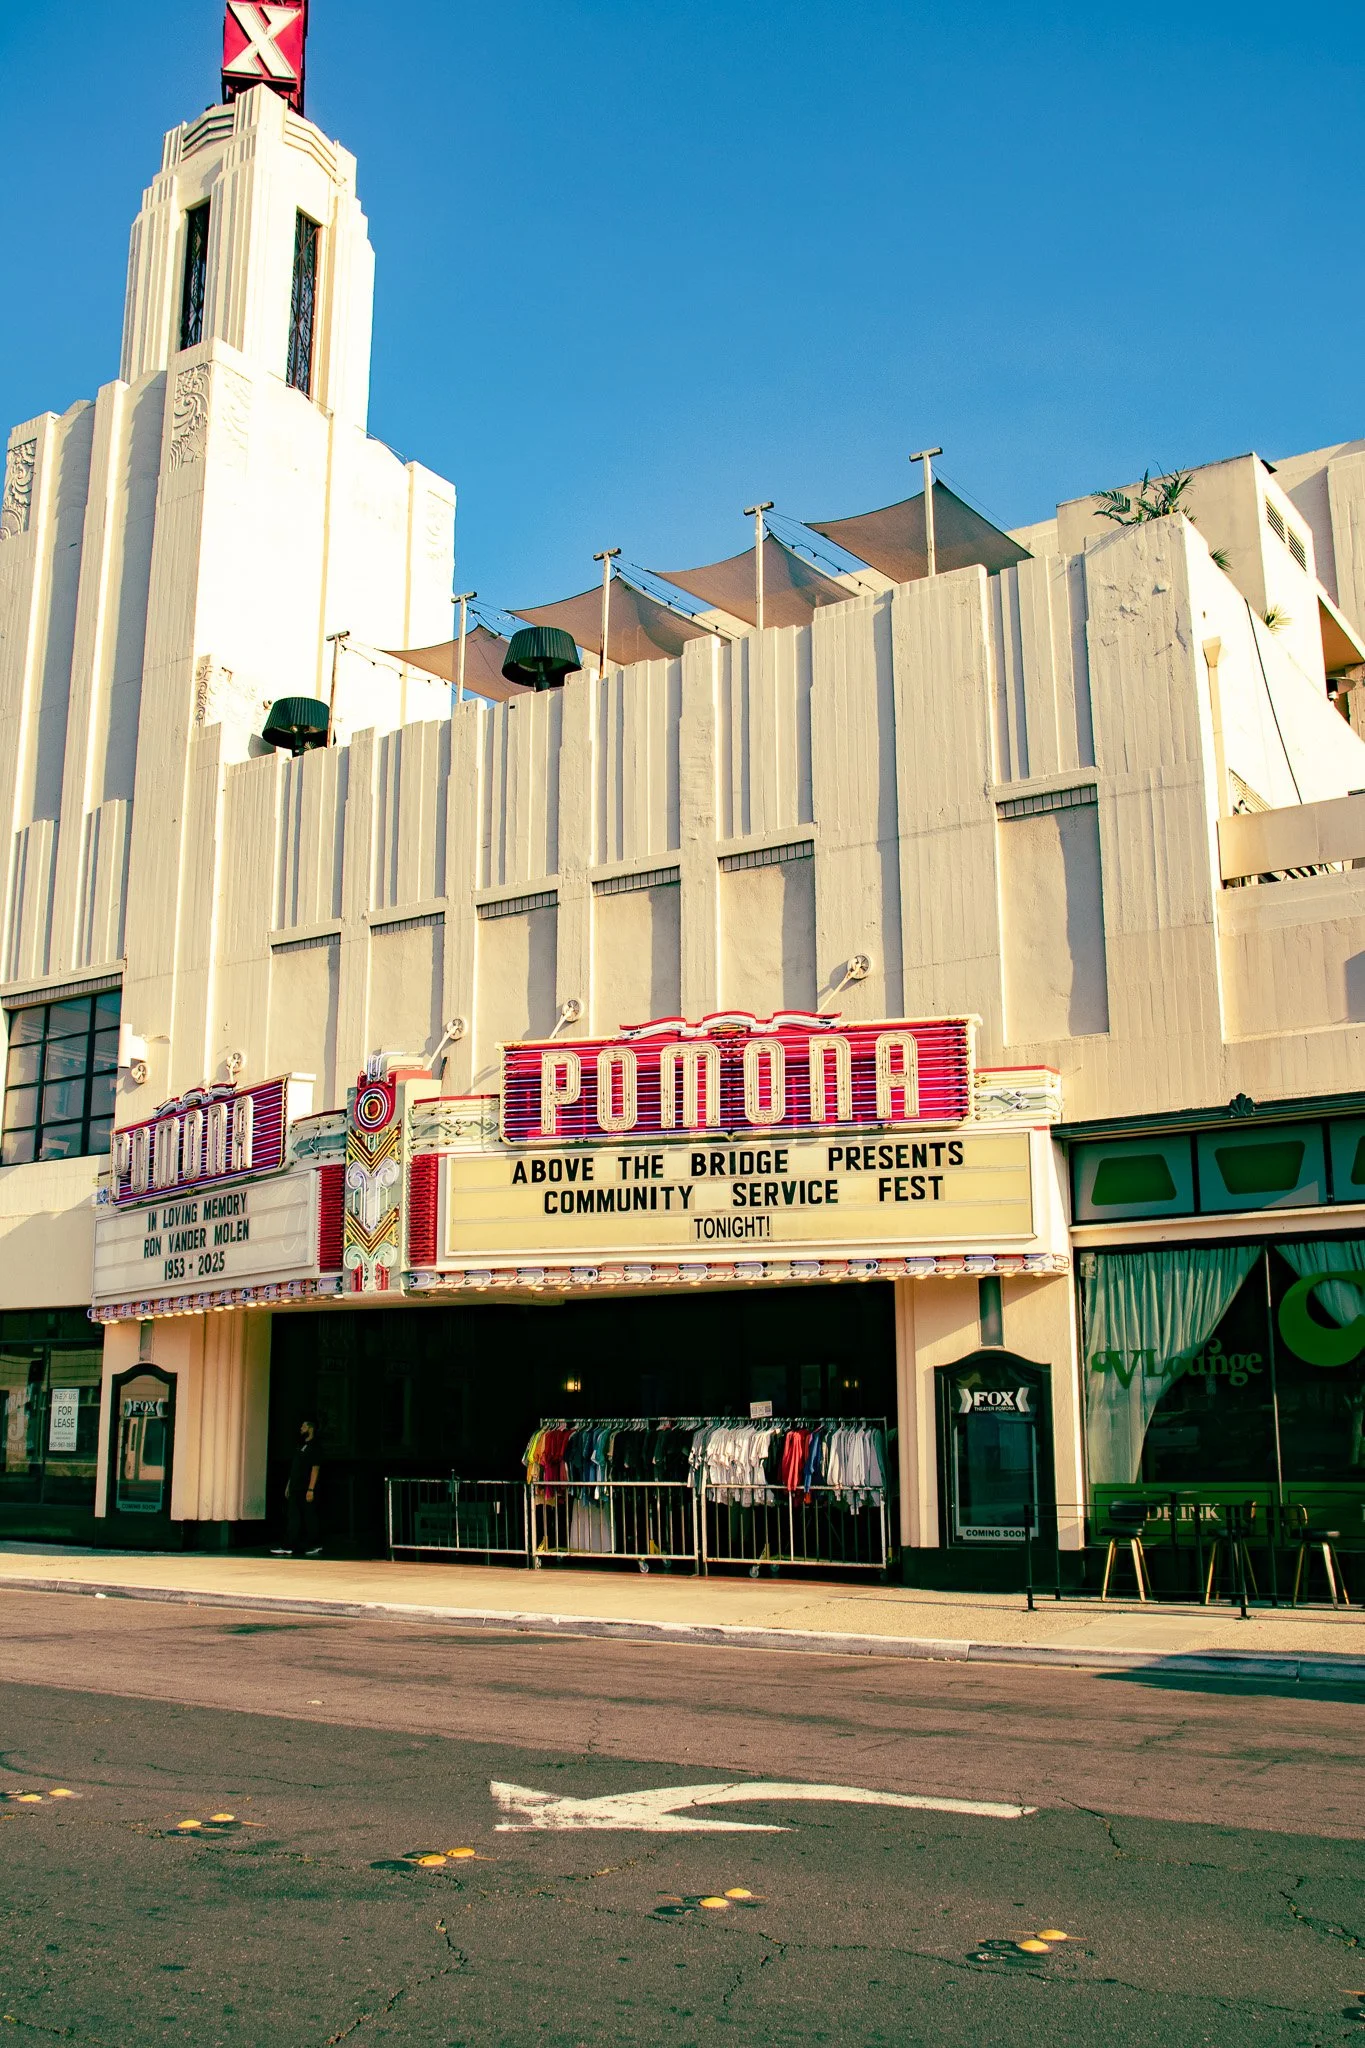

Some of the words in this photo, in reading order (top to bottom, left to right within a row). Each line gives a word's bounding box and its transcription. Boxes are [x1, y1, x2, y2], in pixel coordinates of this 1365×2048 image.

[223, 2, 301, 79] X
[541, 1032, 920, 1135] POMONA
[112, 1095, 254, 1200] POMONA
[512, 1158, 594, 1184] ABOVE
[617, 1154, 664, 1180] THE
[691, 1150, 788, 1177] BRIDGE
[828, 1141, 964, 1171] PRESENTS
[148, 1212, 157, 1232] IN
[163, 1203, 198, 1229] LOVING
[203, 1192, 247, 1221] MEMORY
[544, 1185, 693, 1214] COMMUNITY
[732, 1179, 839, 1207] SERVICE
[878, 1175, 944, 1202] FEST
[144, 1236, 162, 1259] RON
[169, 1228, 206, 1253] VANDER
[214, 1219, 250, 1246] MOLEN
[694, 1216, 770, 1239] TONIGHT!
[164, 1258, 185, 1280] 1953
[198, 1251, 225, 1276] 2025
[1144, 1338, 1263, 1386] Lounge
[57, 1406, 73, 1416] FOR
[132, 1400, 155, 1411] FOX
[973, 1391, 1015, 1406] FOX
[53, 1418, 75, 1428] LEASE
[966, 1529, 1001, 1538] COMING
[1003, 1529, 1029, 1538] SOON
